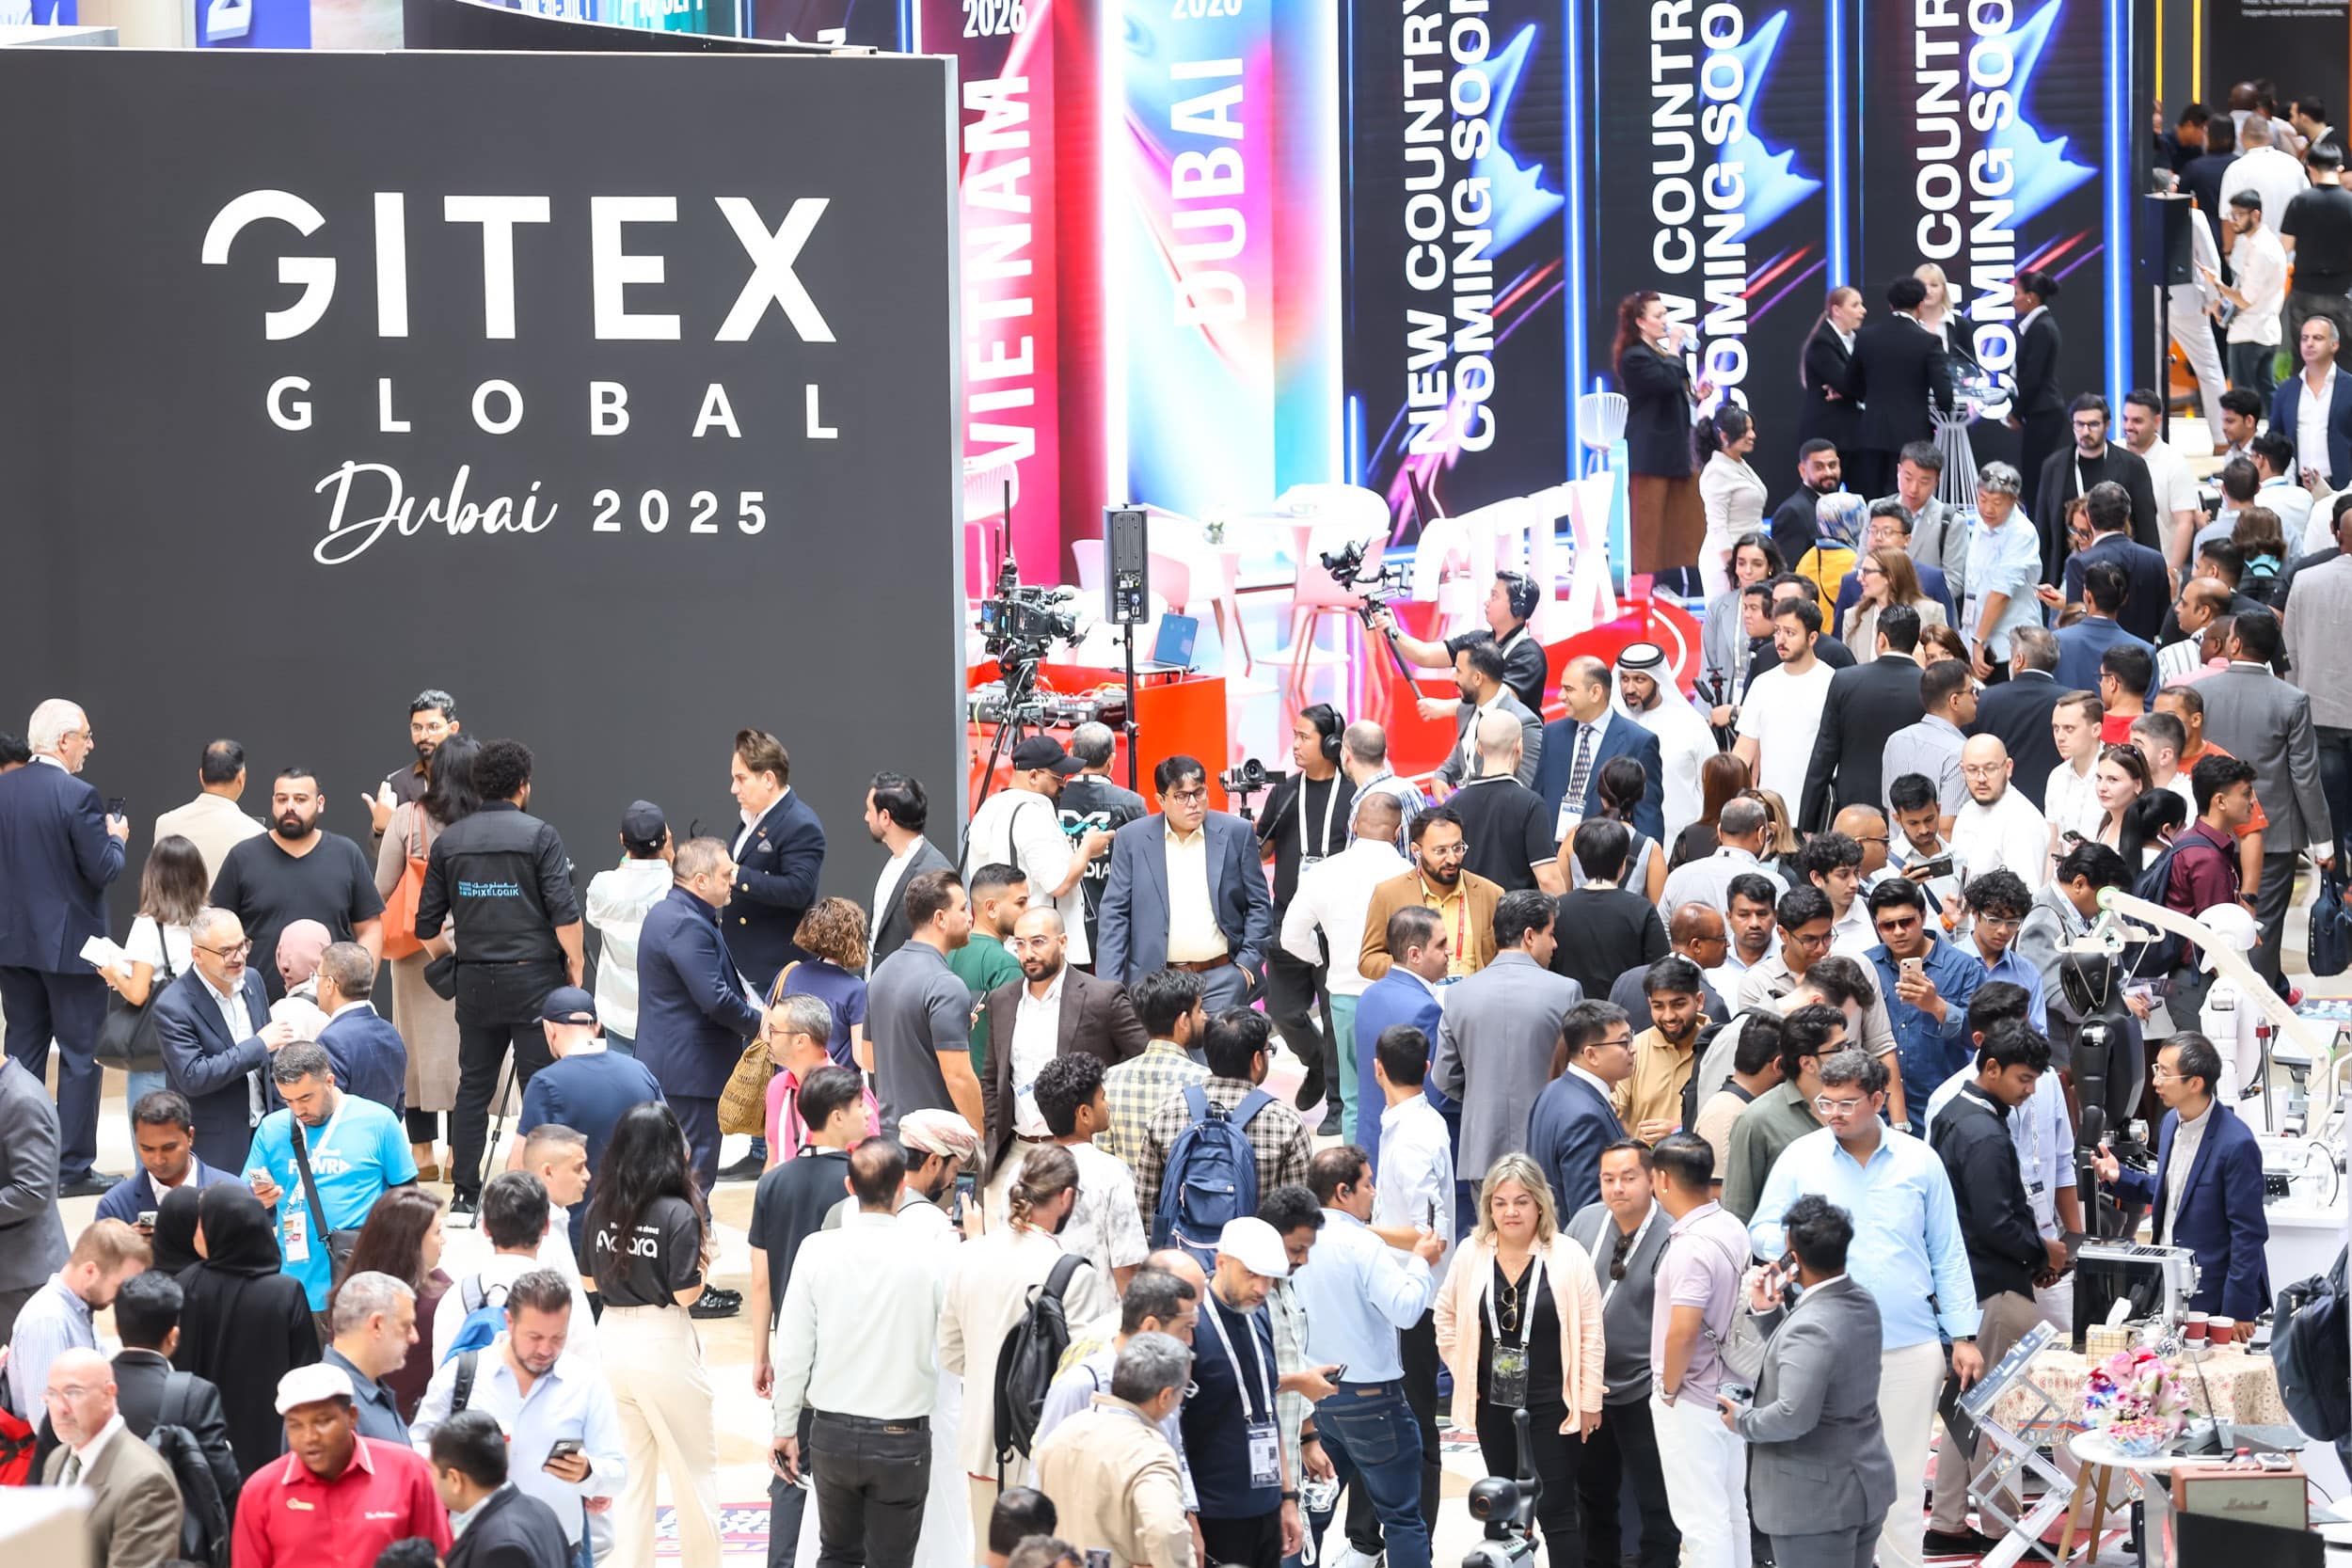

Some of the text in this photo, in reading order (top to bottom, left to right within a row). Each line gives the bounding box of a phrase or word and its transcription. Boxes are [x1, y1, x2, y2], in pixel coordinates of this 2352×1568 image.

[961, 0, 1027, 38] 2026
[201, 189, 837, 342] GITEX
[1170, 58, 1247, 326] DUBAI
[962, 76, 1036, 476] VIETNAM
[1453, 177, 1496, 451] COMING
[266, 376, 838, 439] GLOBAL
[1406, 309, 1449, 454] NEW
[313, 460, 767, 565] Dubai 2025
